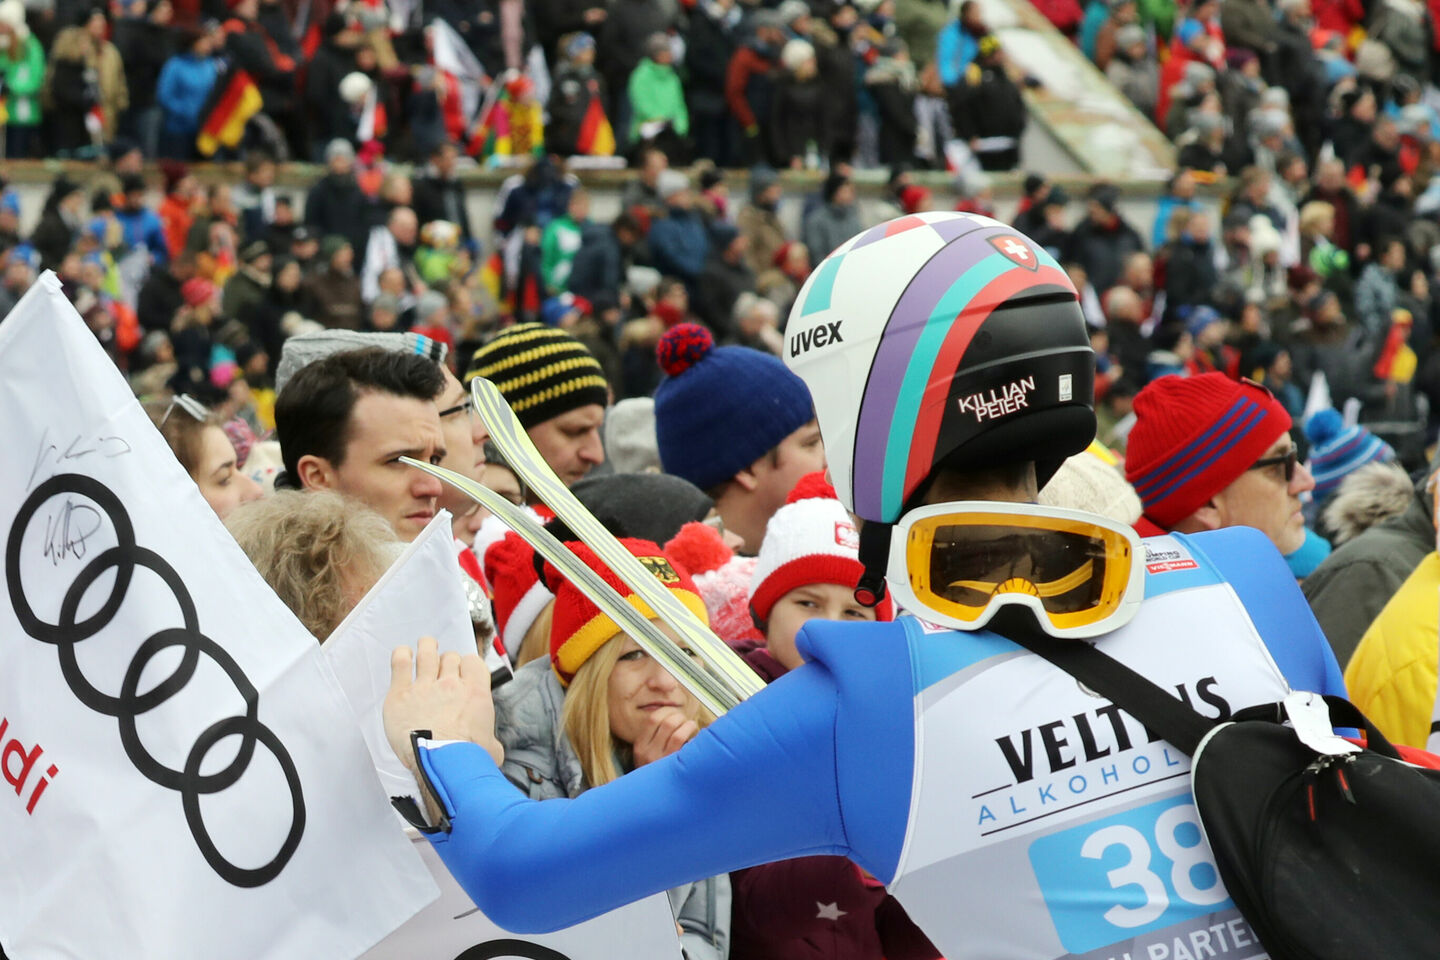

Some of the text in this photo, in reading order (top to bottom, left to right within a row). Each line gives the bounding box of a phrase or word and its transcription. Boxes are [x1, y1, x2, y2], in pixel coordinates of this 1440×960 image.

[791, 320, 843, 358] uvex
[958, 376, 1036, 413] KILLIAN
[975, 394, 1029, 422] PEIER
[995, 676, 1232, 784] VELTS
[978, 748, 1180, 825] ALKOHOL
[1080, 804, 1230, 929] 38
